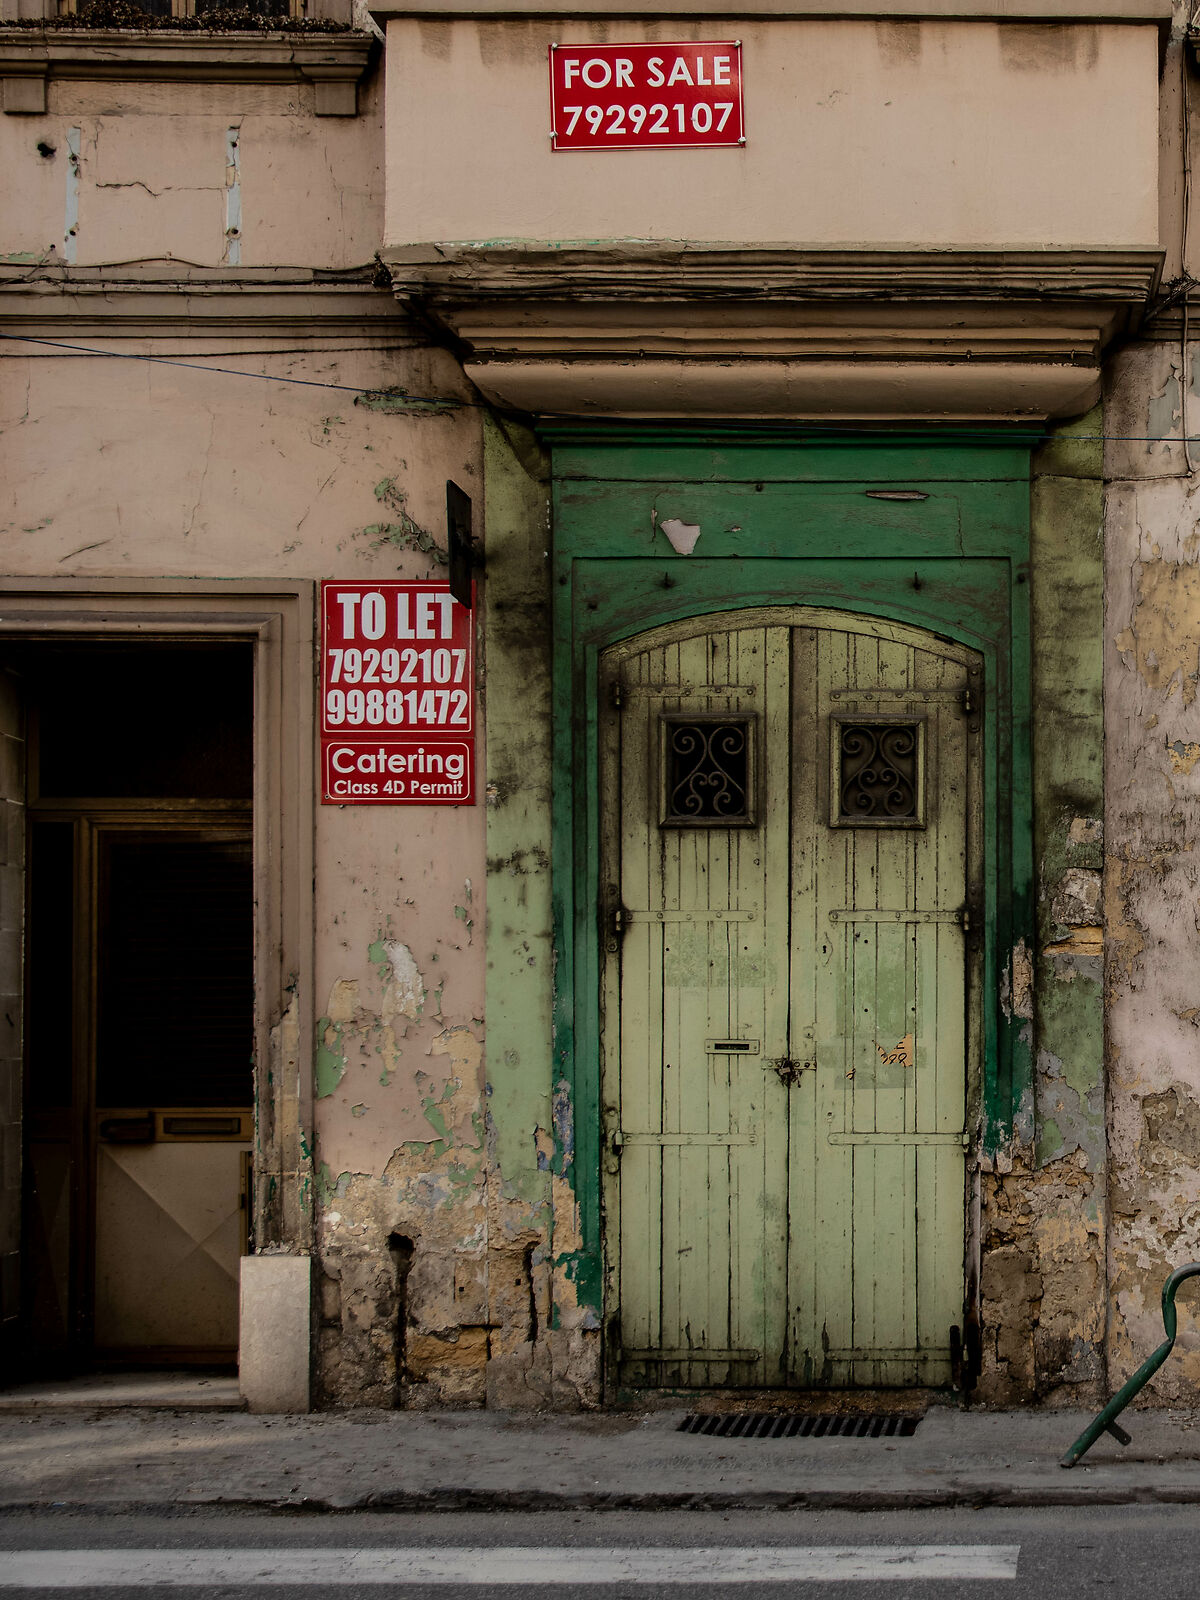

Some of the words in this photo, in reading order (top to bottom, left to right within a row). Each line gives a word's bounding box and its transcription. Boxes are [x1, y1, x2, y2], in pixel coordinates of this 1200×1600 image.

[564, 58, 635, 89] FOR
[646, 56, 731, 87] SALE
[563, 102, 734, 136] 79292107
[336, 591, 387, 640] TO
[397, 592, 459, 640] LET
[328, 648, 467, 684] 79292107
[326, 689, 468, 725] 99881472
[332, 747, 464, 780] Catering
[333, 780, 378, 795] Class
[383, 780, 406, 795] 4D
[411, 779, 463, 795] Permit
